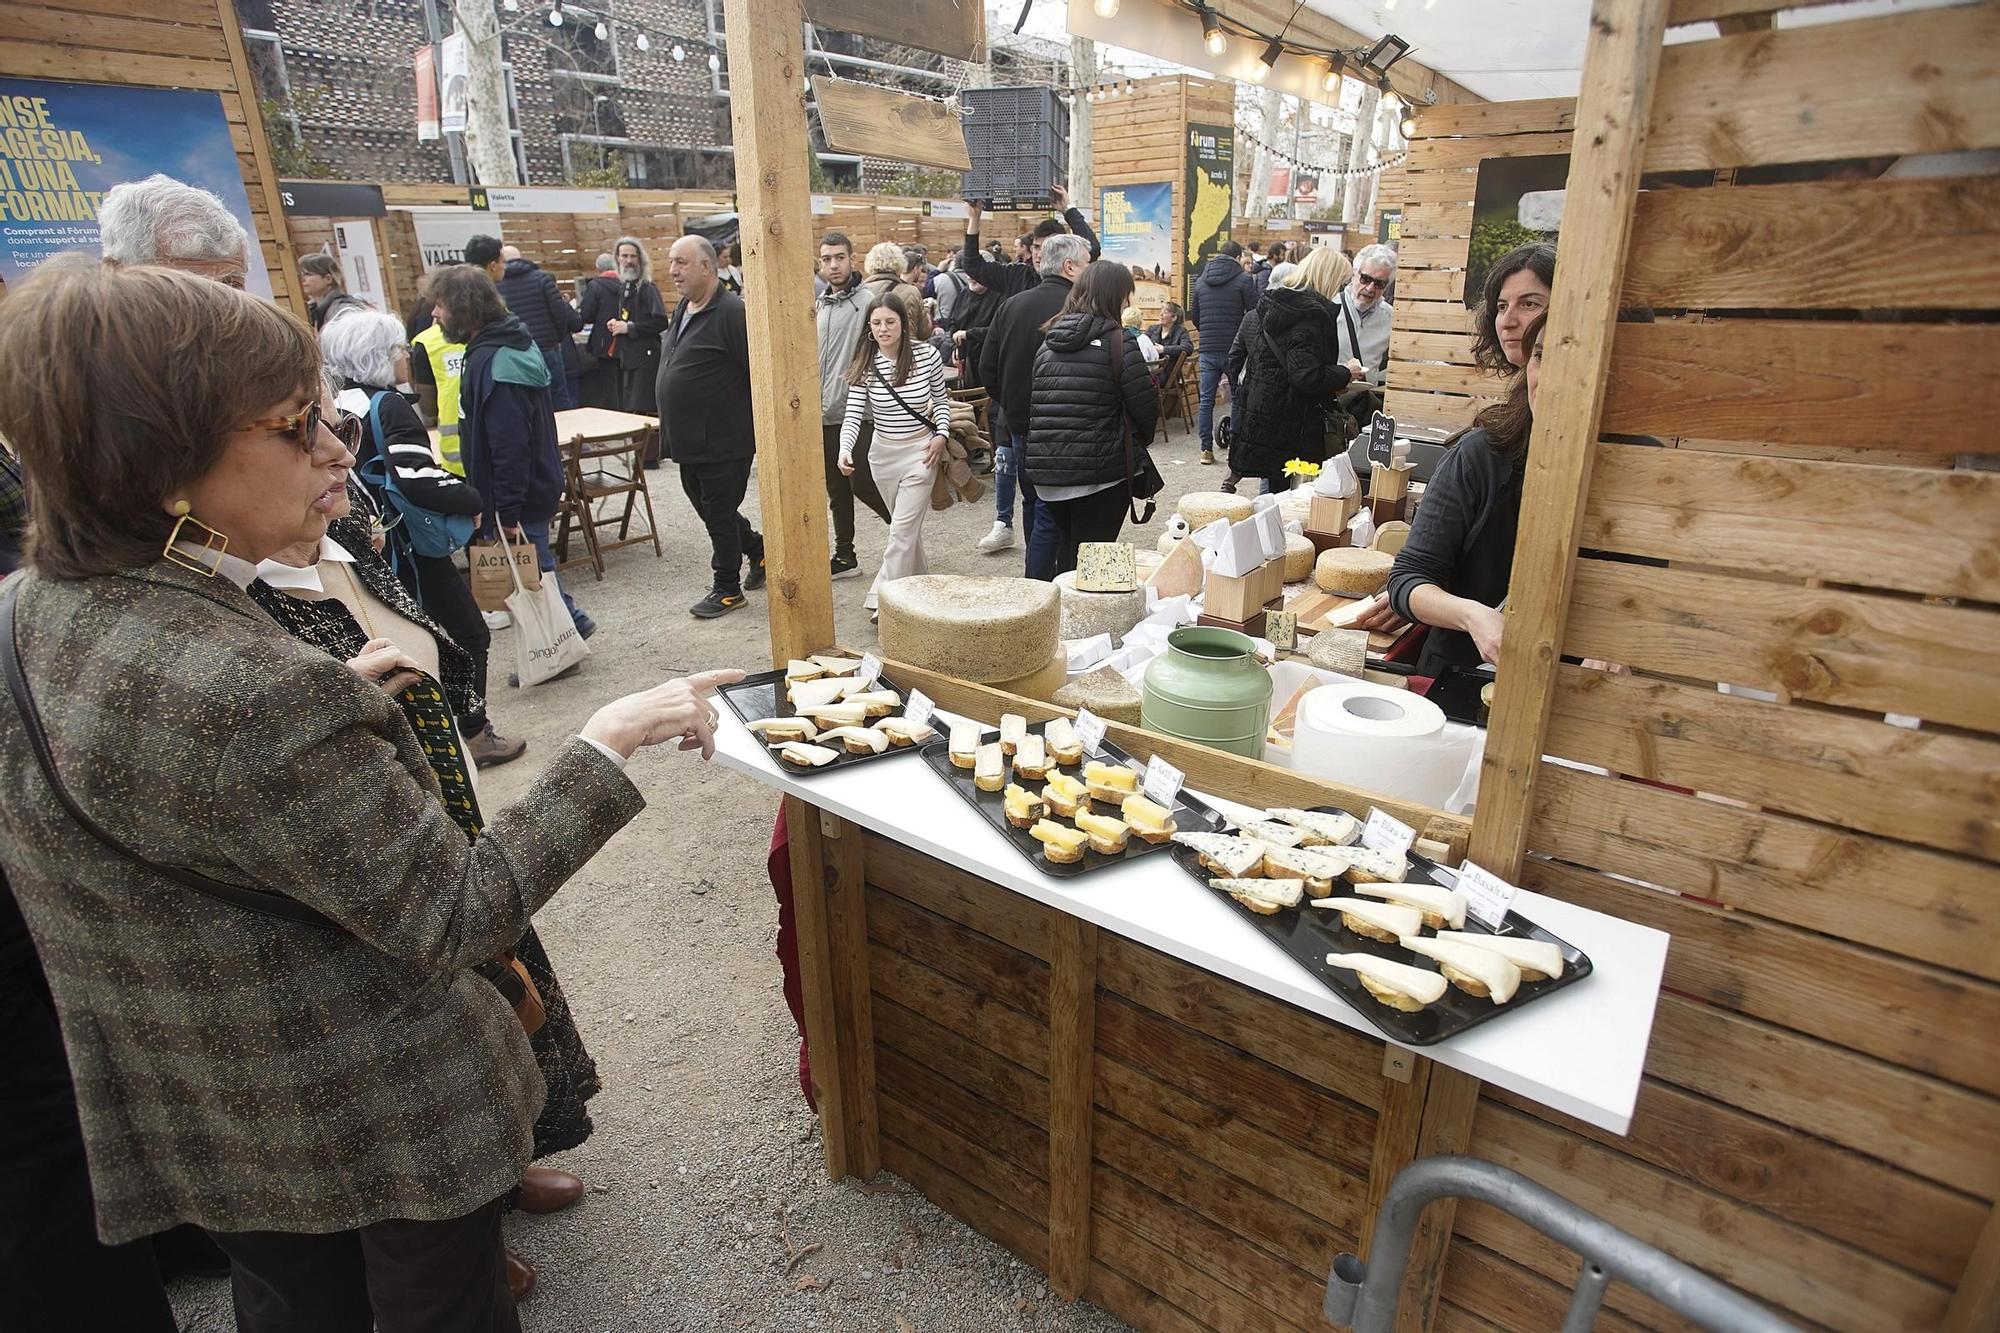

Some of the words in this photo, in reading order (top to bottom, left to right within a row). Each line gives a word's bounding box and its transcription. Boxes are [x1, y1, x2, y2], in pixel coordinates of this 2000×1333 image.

[14, 159, 80, 191] UNA
[0, 190, 104, 221] FORMAT
[473, 194, 486, 207] 40
[4, 227, 56, 236] Comprant
[57, 226, 66, 234] al
[67, 226, 98, 235] Fòrum
[8, 237, 42, 245] donant
[44, 236, 77, 245] suport
[78, 235, 88, 243] al
[12, 250, 28, 259] Per
[15, 259, 40, 268] local
[447, 358, 463, 371] SE
